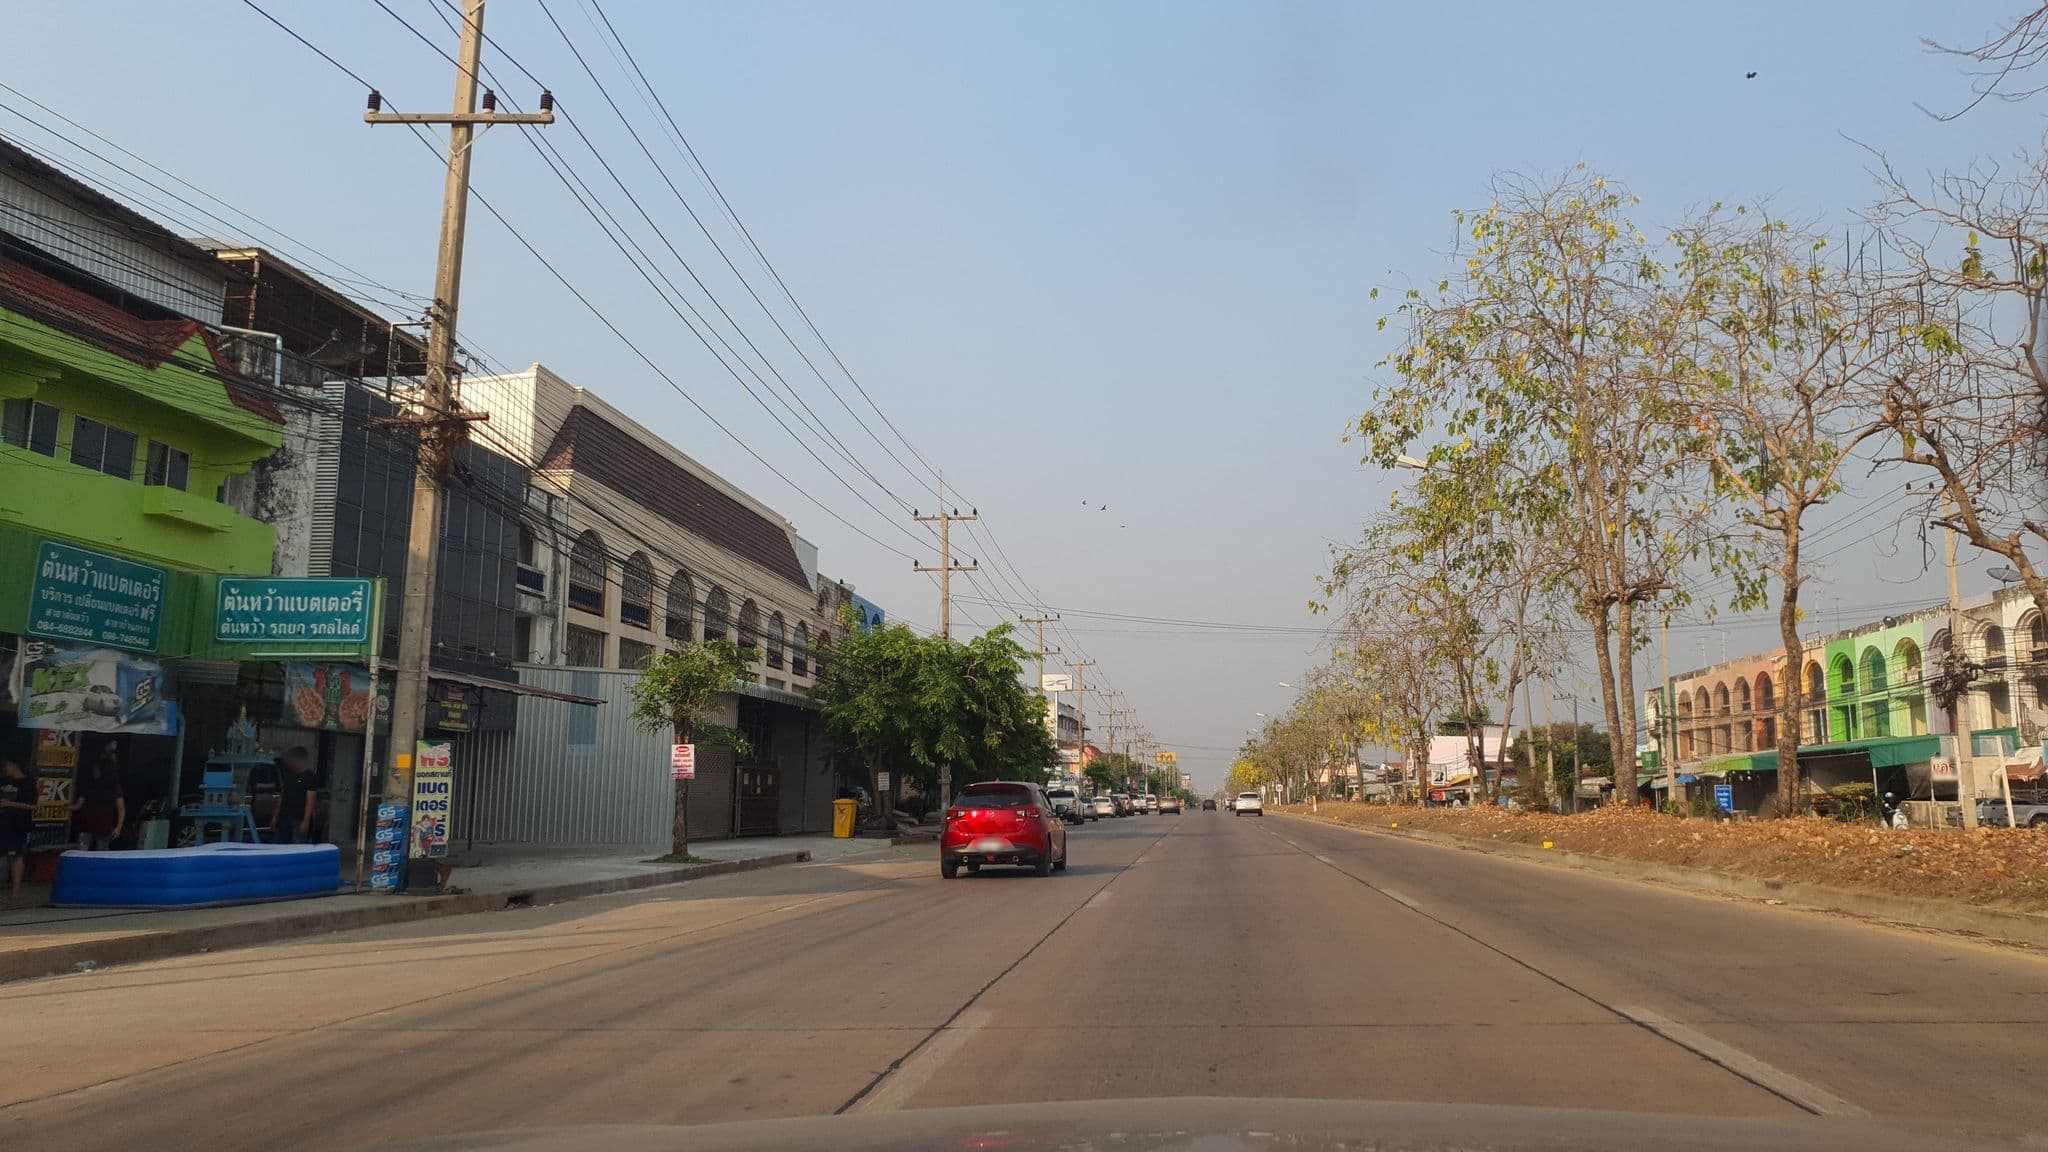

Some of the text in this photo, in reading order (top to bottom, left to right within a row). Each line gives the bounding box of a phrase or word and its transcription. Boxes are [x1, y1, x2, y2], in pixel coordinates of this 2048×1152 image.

[42, 551, 161, 601] ต้นหว้าแบตเตอรี่
[223, 585, 364, 612] ต้นหว้าแบตเตอรี่
[221, 617, 265, 634] ต้นหว้า
[417, 782, 449, 794] แบต
[33, 806, 69, 818] BATTER
[378, 806, 396, 818] GS
[375, 828, 394, 840] GS
[373, 850, 392, 862] GS
[371, 873, 390, 885] GS
